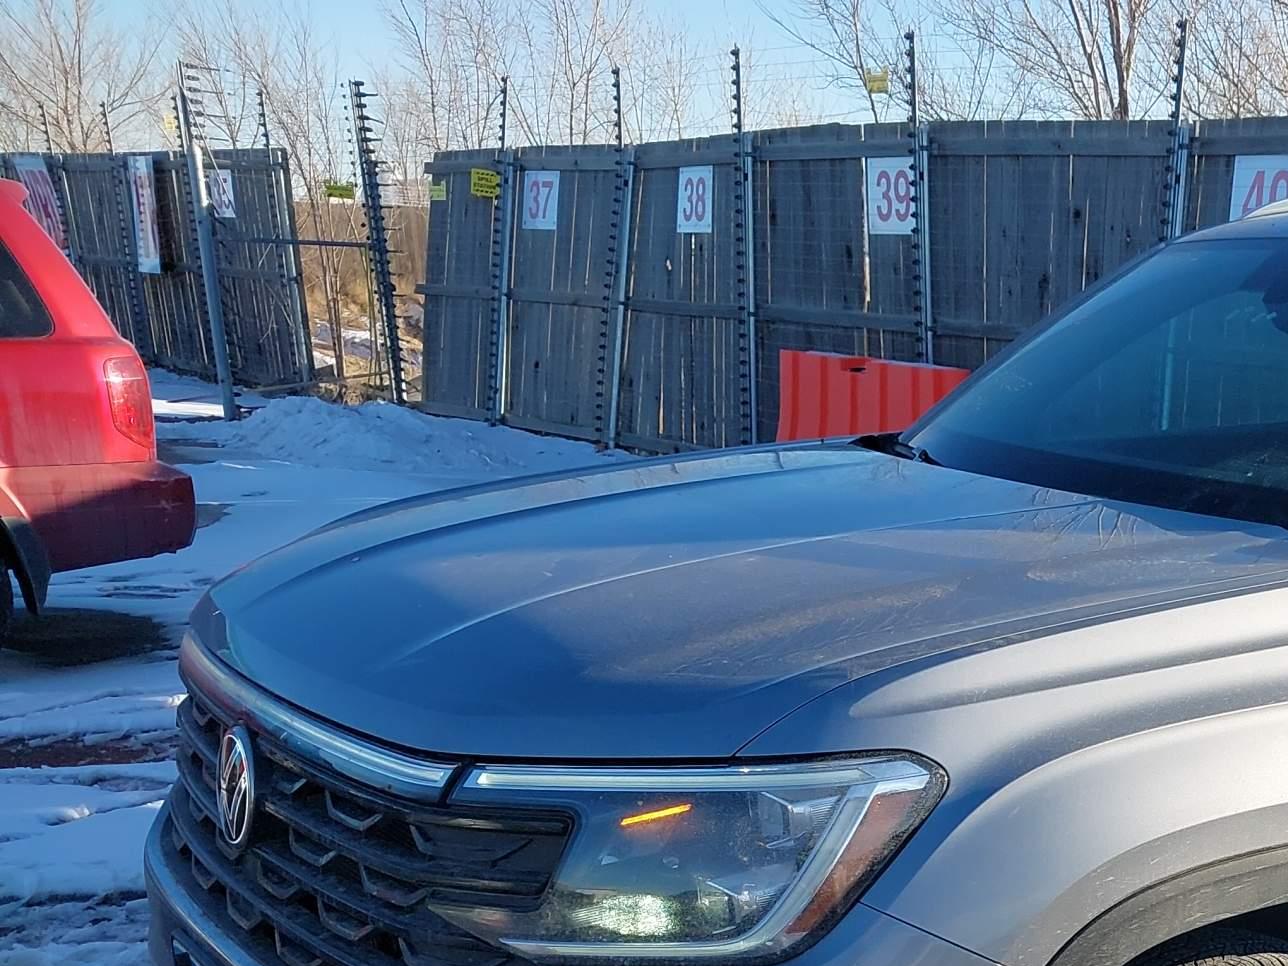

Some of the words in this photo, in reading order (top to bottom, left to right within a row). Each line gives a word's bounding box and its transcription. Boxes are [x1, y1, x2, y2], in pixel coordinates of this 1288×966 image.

[528, 180, 554, 219] 37
[683, 177, 706, 222] 38
[876, 170, 912, 222] 39
